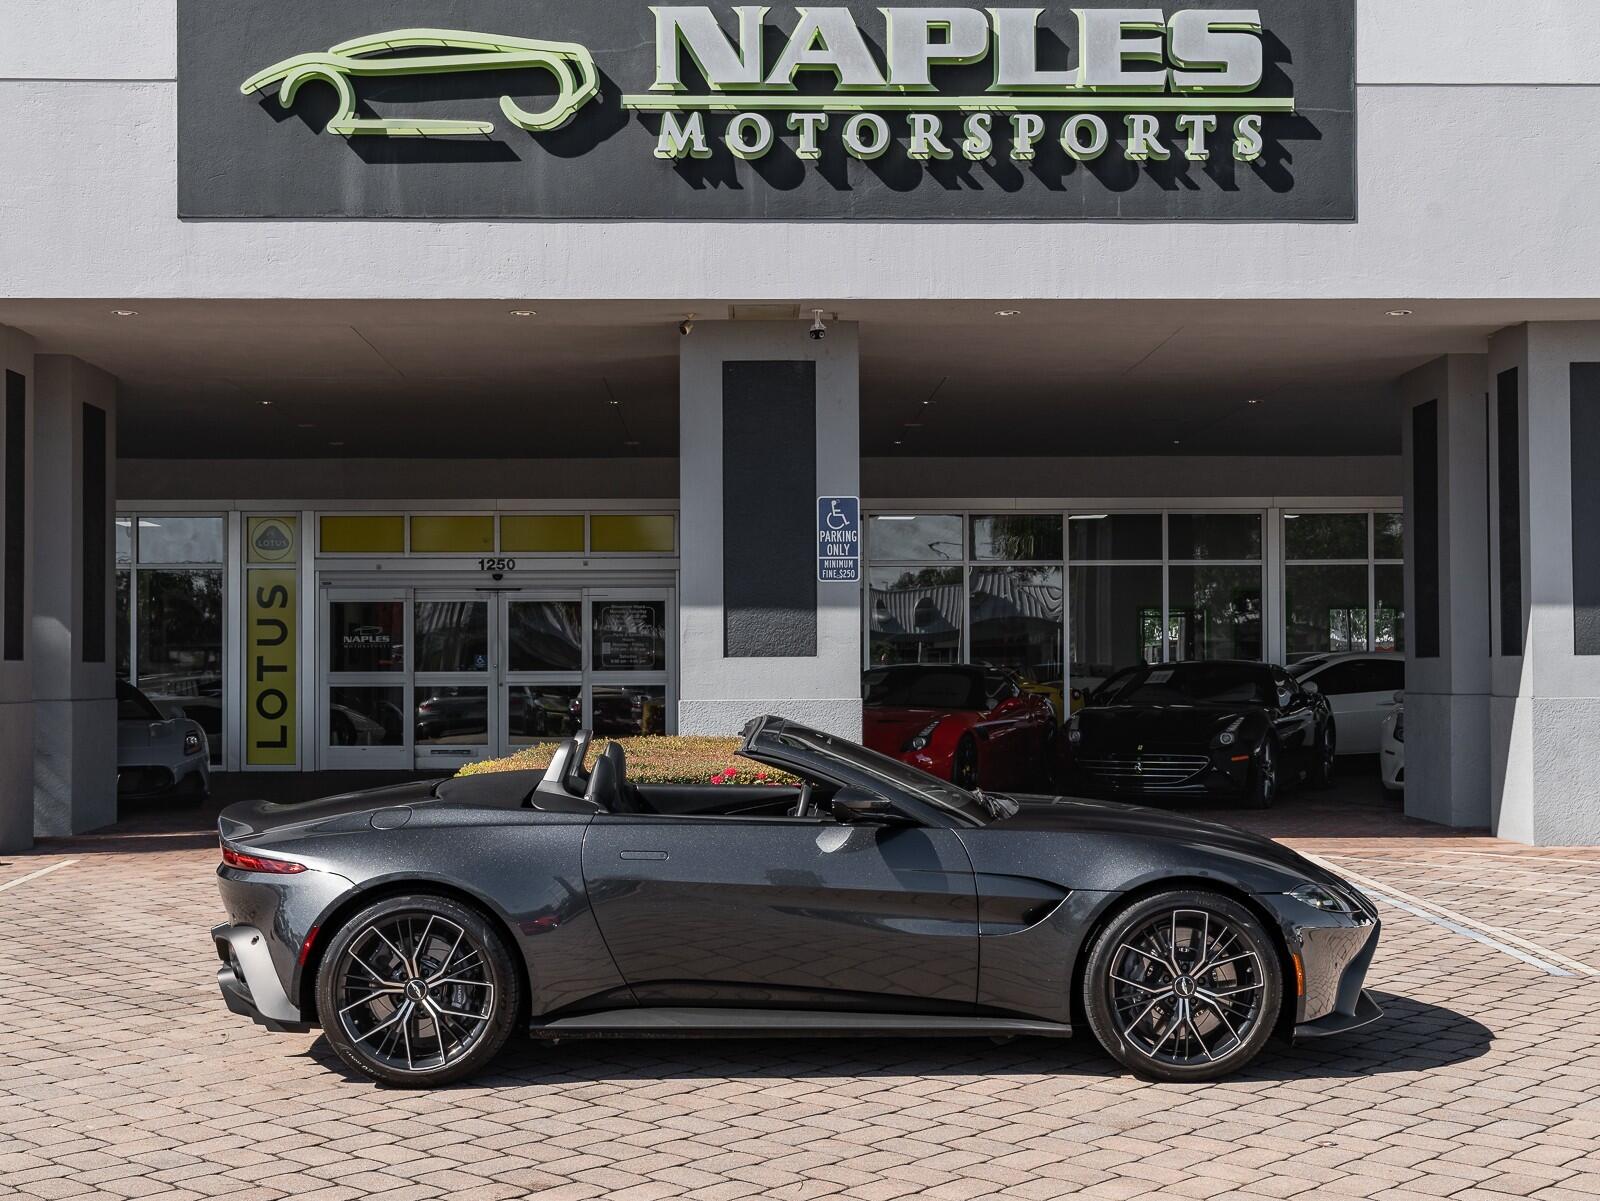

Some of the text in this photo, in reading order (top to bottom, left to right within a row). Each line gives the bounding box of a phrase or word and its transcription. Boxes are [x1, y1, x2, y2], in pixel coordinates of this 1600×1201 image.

[649, 5, 1264, 92] NAPLES
[653, 111, 1263, 162] MOTORSPORTS
[820, 530, 857, 542] PARKING
[258, 539, 287, 547] LOTUS
[827, 543, 850, 556] ONLY
[478, 559, 516, 571] 1250
[824, 560, 854, 568] MINIMUM
[822, 569, 855, 578] FINE $250
[256, 584, 288, 749] LOTUS
